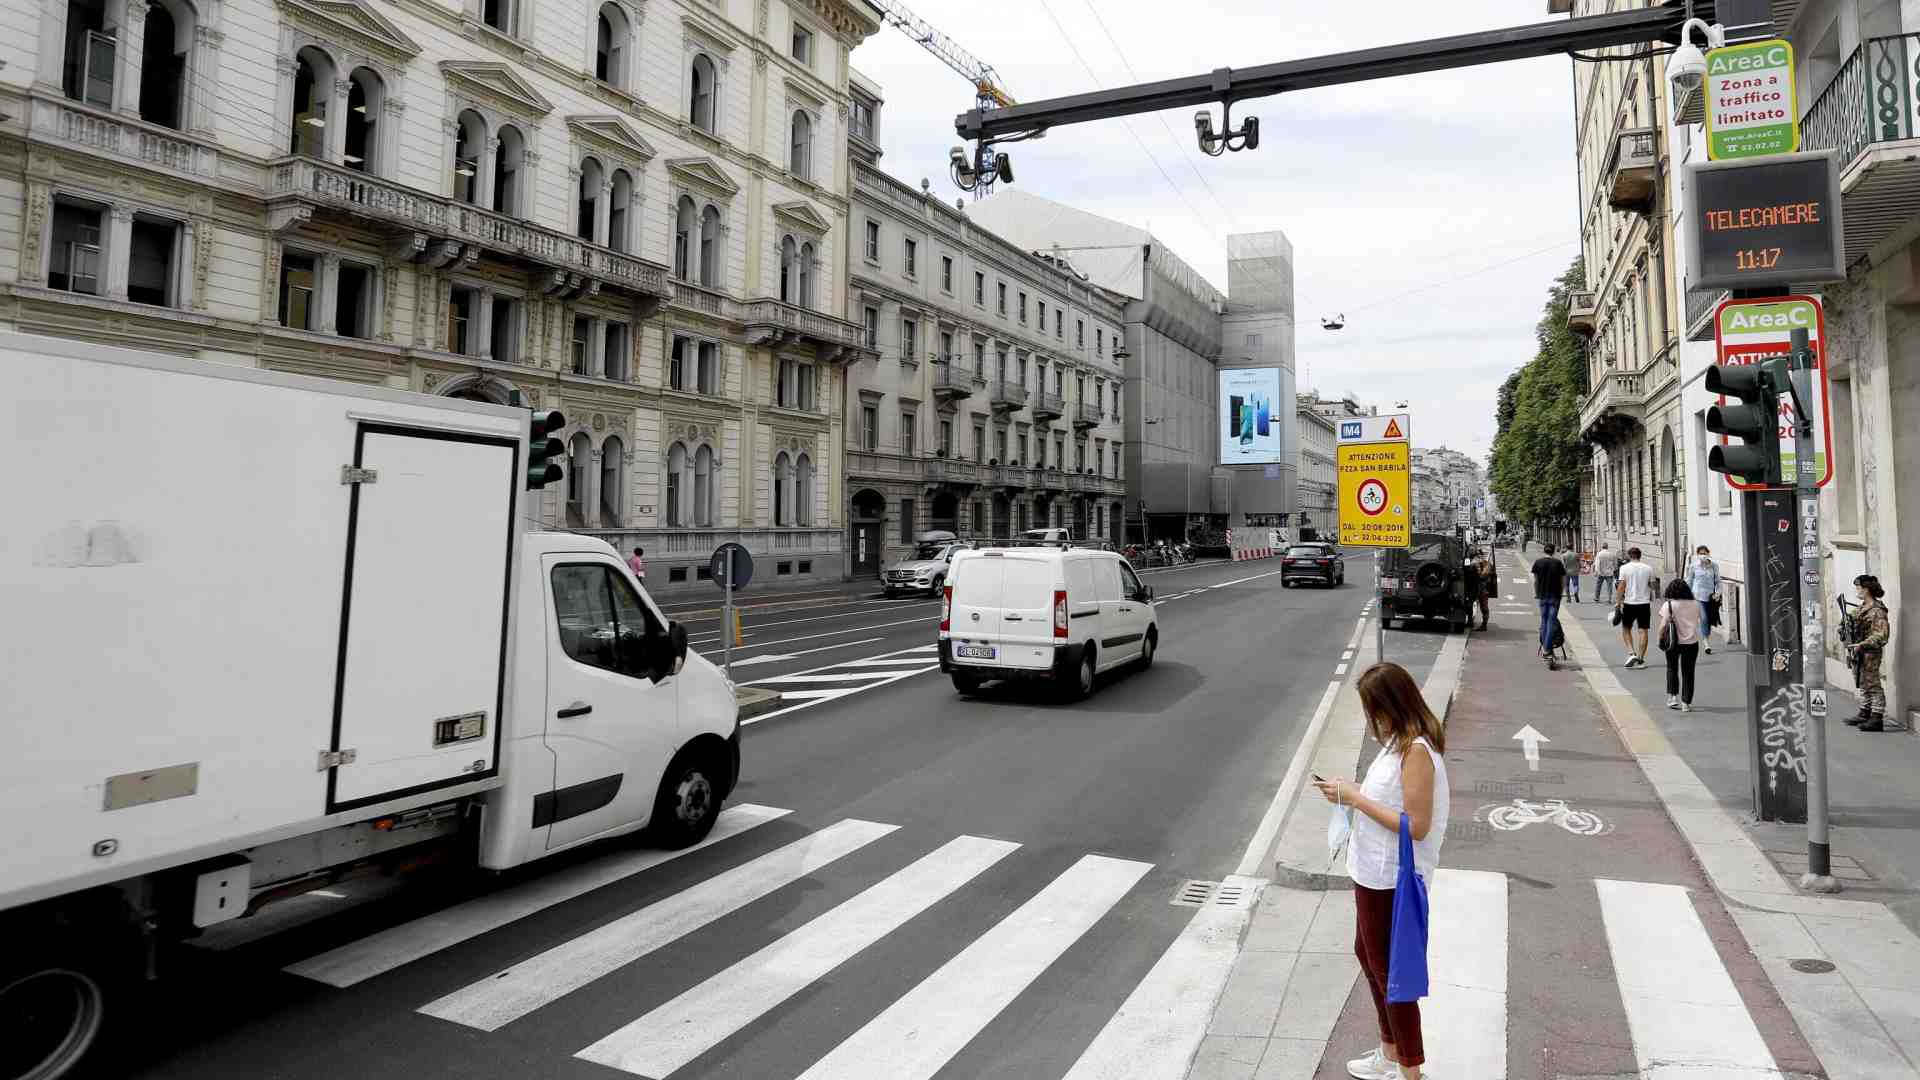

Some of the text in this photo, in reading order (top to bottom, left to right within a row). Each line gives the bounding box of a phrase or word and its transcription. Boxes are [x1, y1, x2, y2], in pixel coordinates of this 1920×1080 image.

[1720, 76, 1778, 91] Zona a
[1719, 91, 1781, 107] traffico
[1718, 108, 1785, 125] limitato
[1706, 202, 1820, 231] TELECAMERE
[1735, 248, 1784, 270] 11:17
[1348, 451, 1396, 461] ATTENZIONE
[1360, 463, 1376, 472] SAN
[1378, 463, 1407, 472] BABILA
